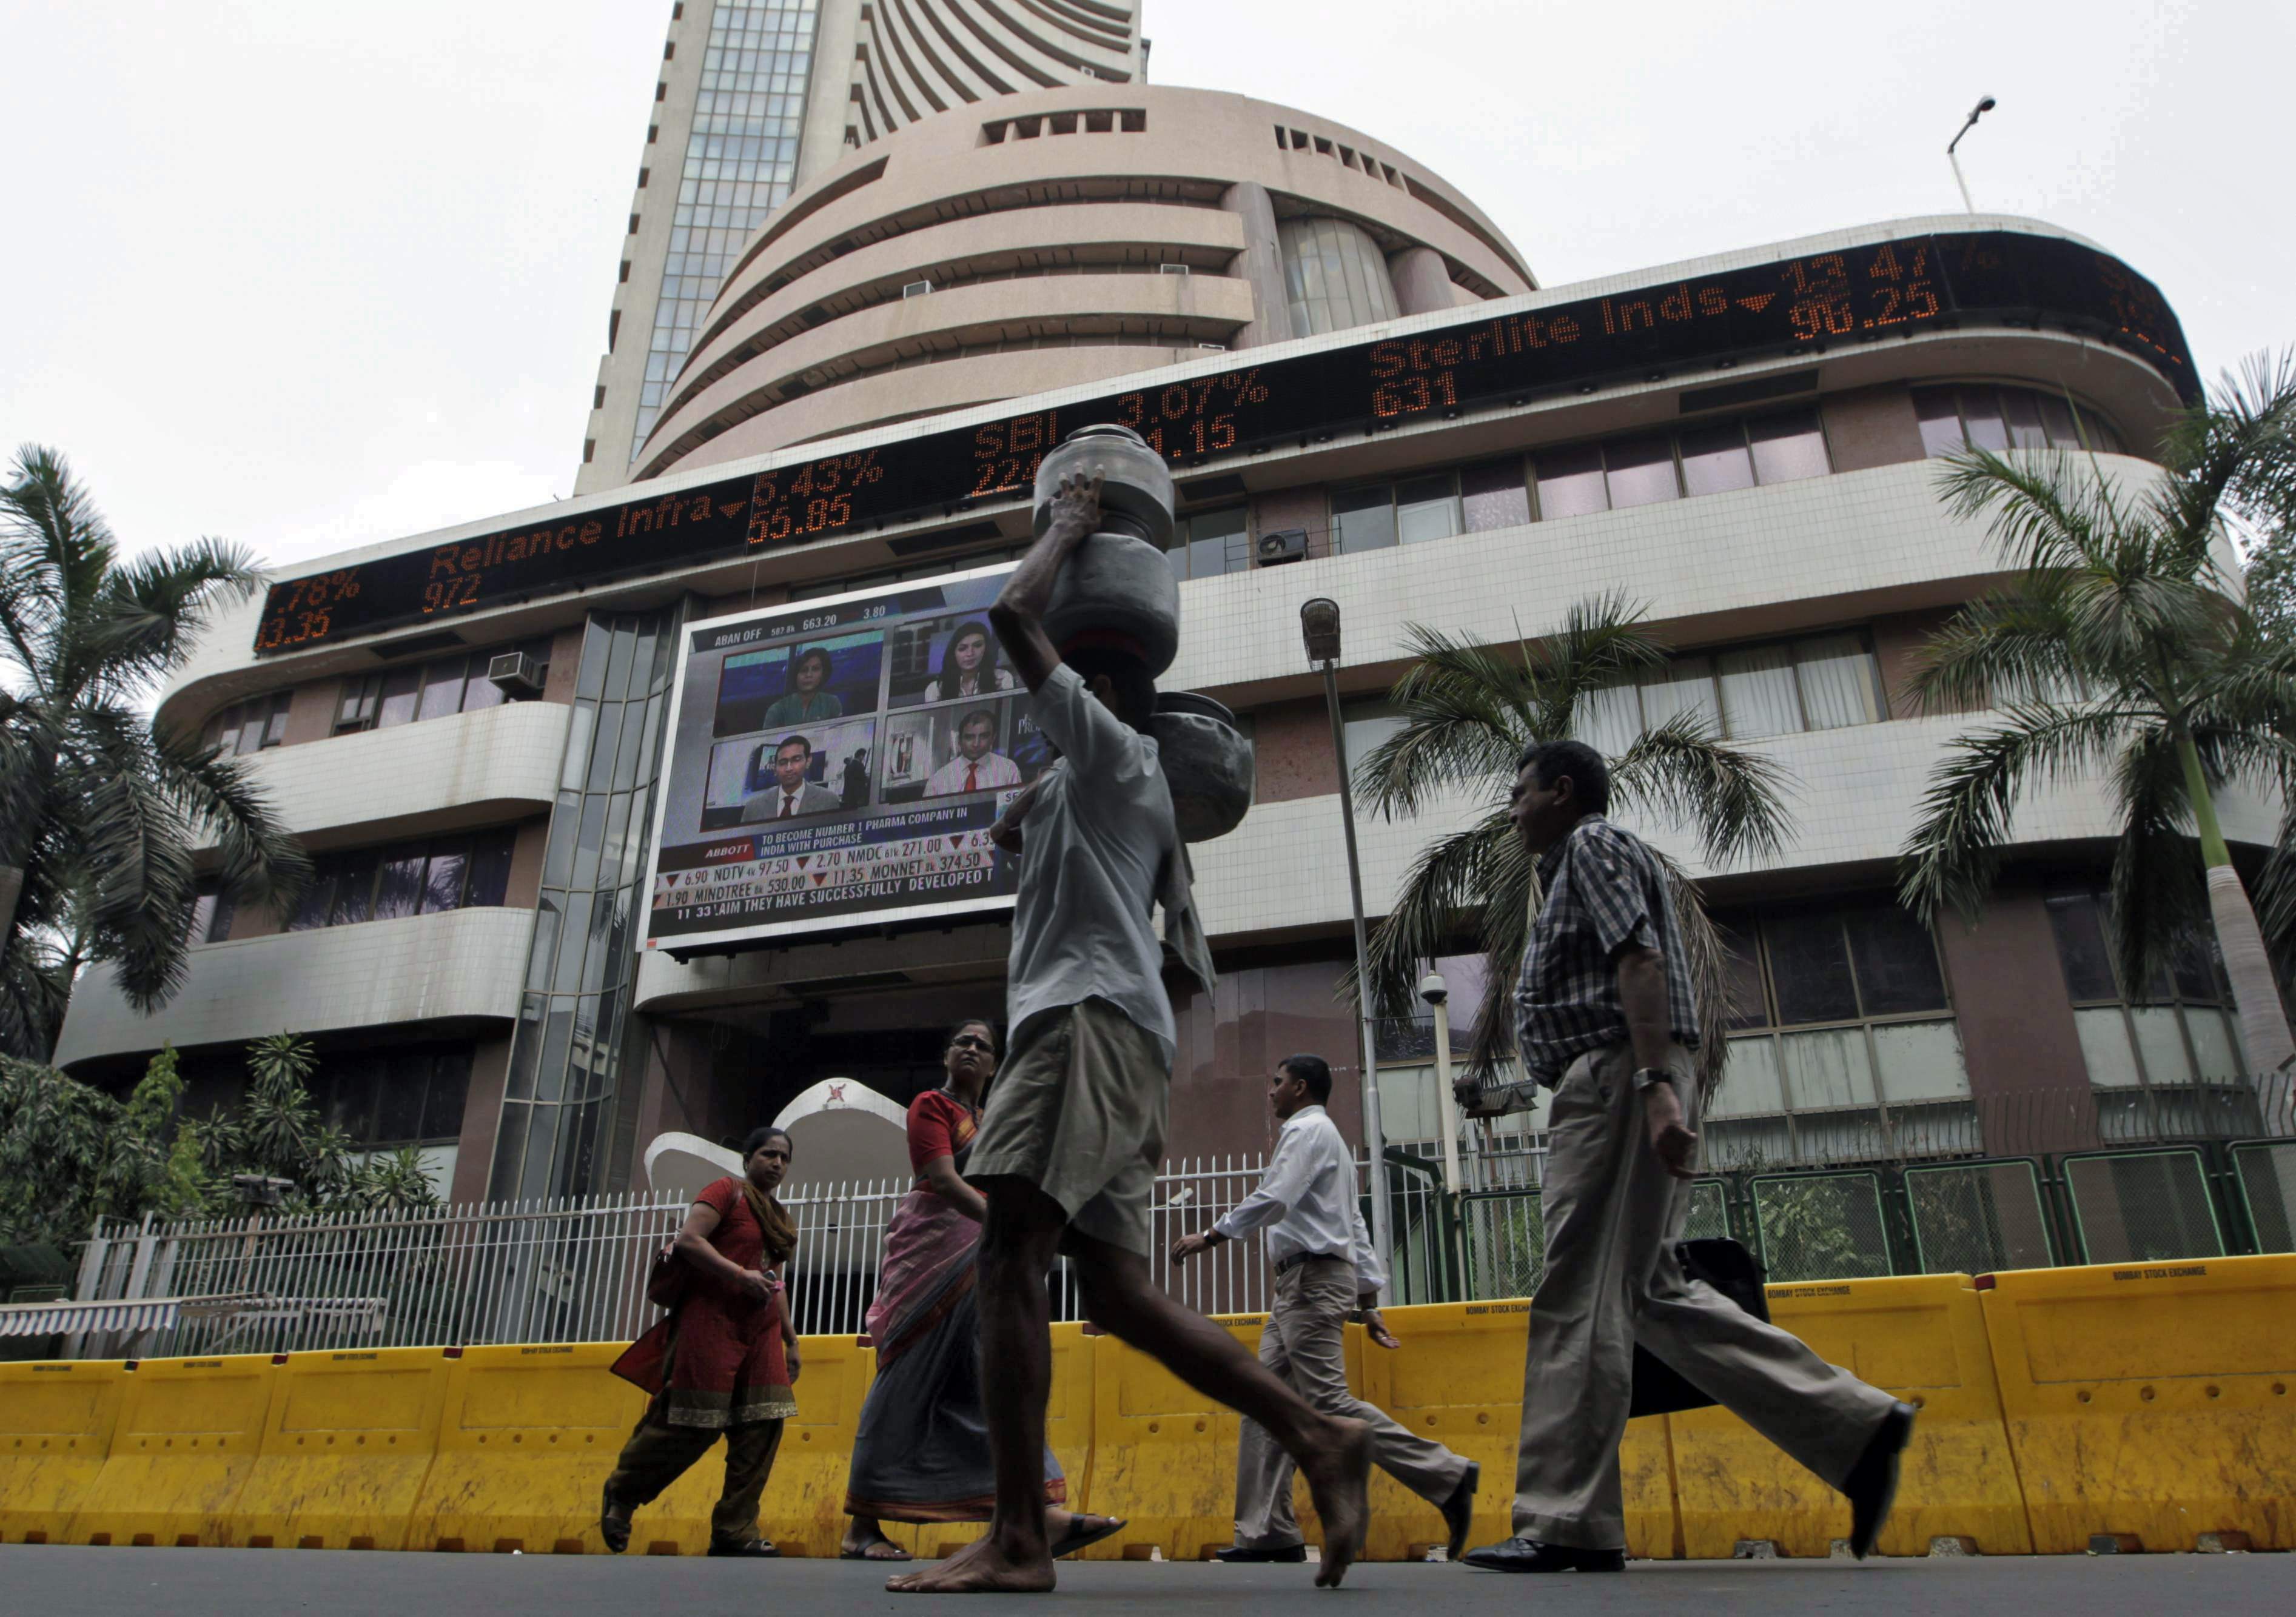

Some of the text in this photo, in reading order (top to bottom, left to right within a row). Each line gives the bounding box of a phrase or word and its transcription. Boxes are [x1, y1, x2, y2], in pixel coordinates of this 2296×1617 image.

[1371, 283, 1727, 378] Sterlite Inds
[1116, 367, 1269, 427] 3.07%
[1372, 370, 1457, 417] 631
[974, 411, 1056, 459] SBI
[752, 450, 883, 507] 5.43%
[429, 495, 711, 578] Reliance Infra
[748, 493, 851, 543] 55.85
[424, 574, 481, 612] 972
[715, 632, 740, 647] ABAN
[743, 628, 762, 641] OFF
[802, 614, 837, 631] 663.20
[863, 605, 885, 620] 3.80
[761, 833, 862, 857] INDIA WITH PURCHASE
[762, 807, 967, 845] TO BECOME NUMBER 1 PHARMA COMPANY IN
[685, 872, 708, 886] 6.90
[714, 866, 744, 882] NDTV
[759, 859, 788, 875] 97.50
[817, 852, 841, 868] 2.70
[848, 845, 882, 862] NMDC
[902, 839, 941, 857] 271.00
[705, 844, 750, 859] ABBOTT
[666, 891, 688, 906] 1.90
[694, 883, 751, 903] MINDTREE
[768, 876, 805, 892] 530.00
[833, 869, 863, 885] 11.35
[870, 860, 922, 879] MONNET
[940, 852, 980, 869] 374.50
[745, 897, 772, 911] THEY
[776, 893, 805, 907] HAVE
[810, 880, 901, 903] SUCCESSFULLY
[909, 871, 982, 891] DEVELOPED
[1768, 1289, 1793, 1298] BOMBAY
[2144, 1269, 2167, 1279] STOCK
[2169, 1266, 2206, 1277] EXCHANGE
[1235, 1317, 1262, 1326] EXCHANGE
[1466, 1306, 1489, 1314] BOMBAY
[1491, 1305, 1510, 1314] STOCK
